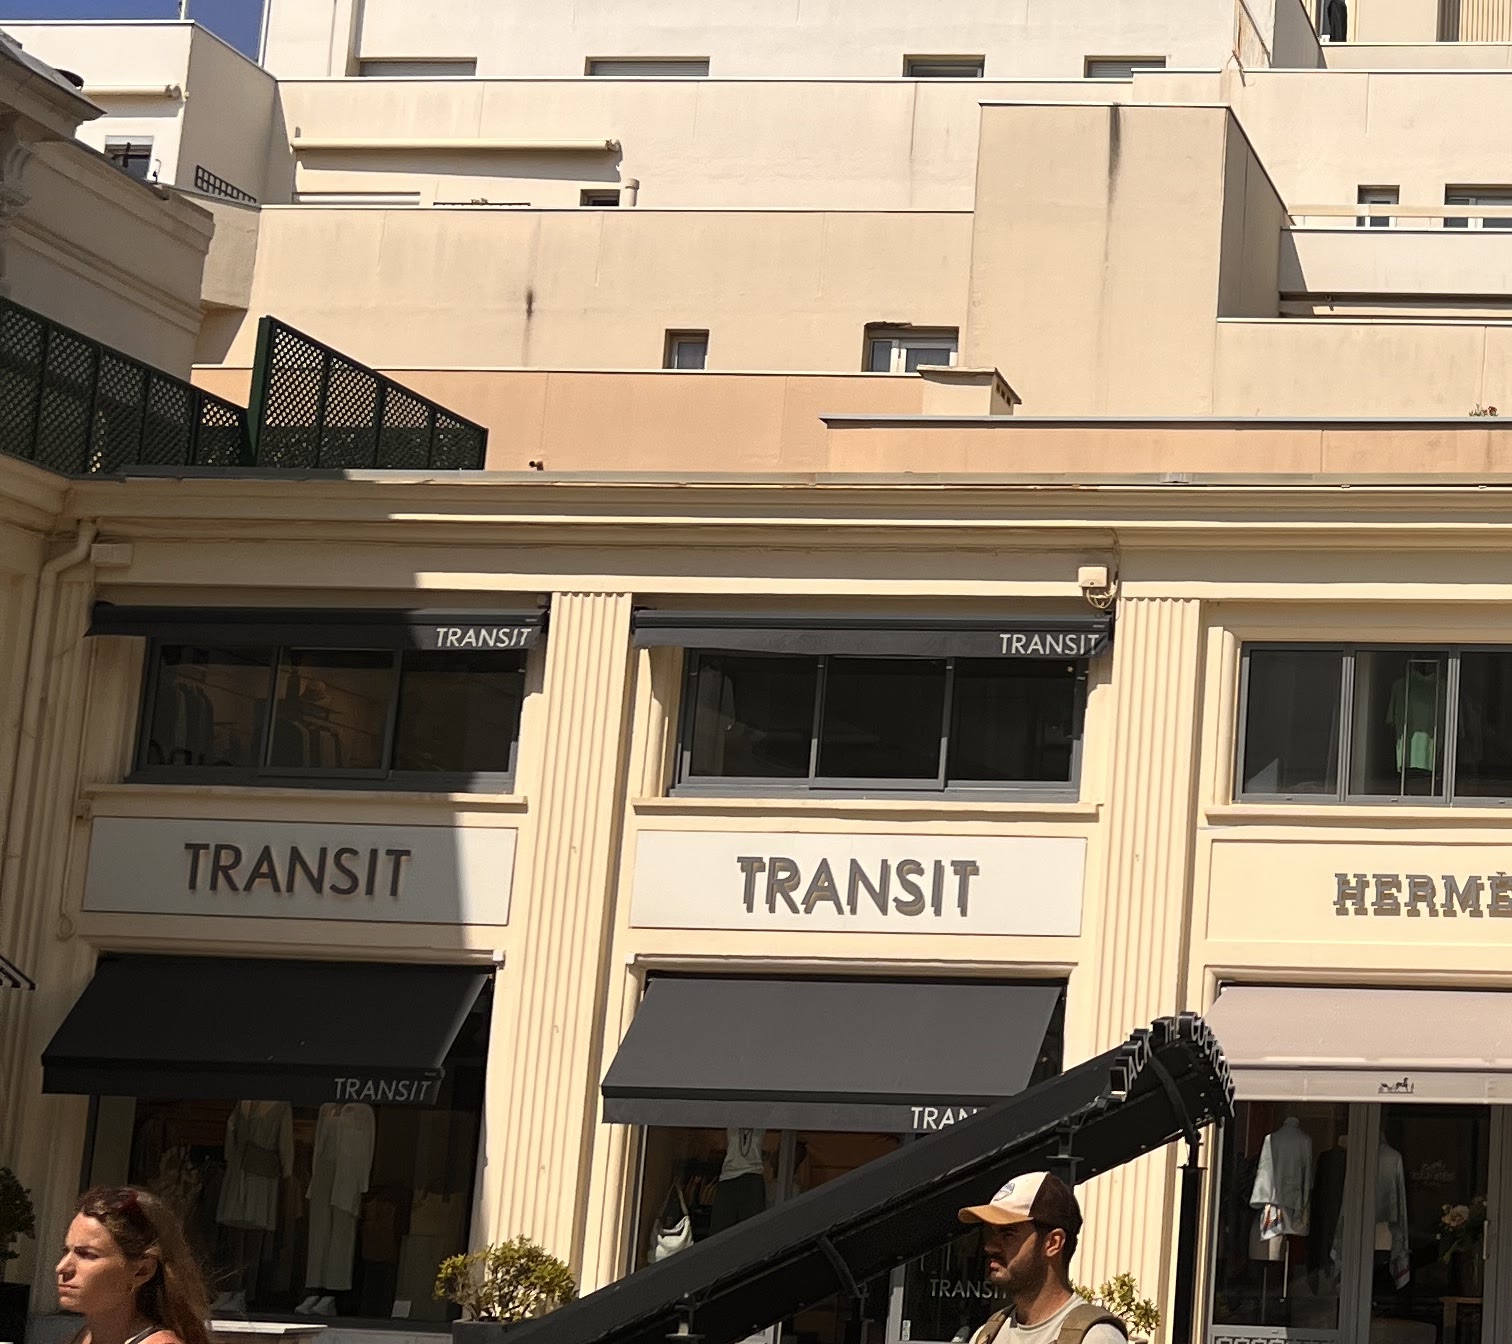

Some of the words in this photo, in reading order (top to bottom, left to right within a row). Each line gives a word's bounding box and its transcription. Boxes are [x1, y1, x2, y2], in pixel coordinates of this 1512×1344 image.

[436, 627, 532, 648] TRANSIT
[999, 633, 1100, 656] TRANSIT
[184, 842, 412, 896] TRANSIT
[736, 856, 980, 917] TRANSIT
[1110, 1029, 1153, 1104] JACK
[334, 1077, 433, 1101] TRANSIT
